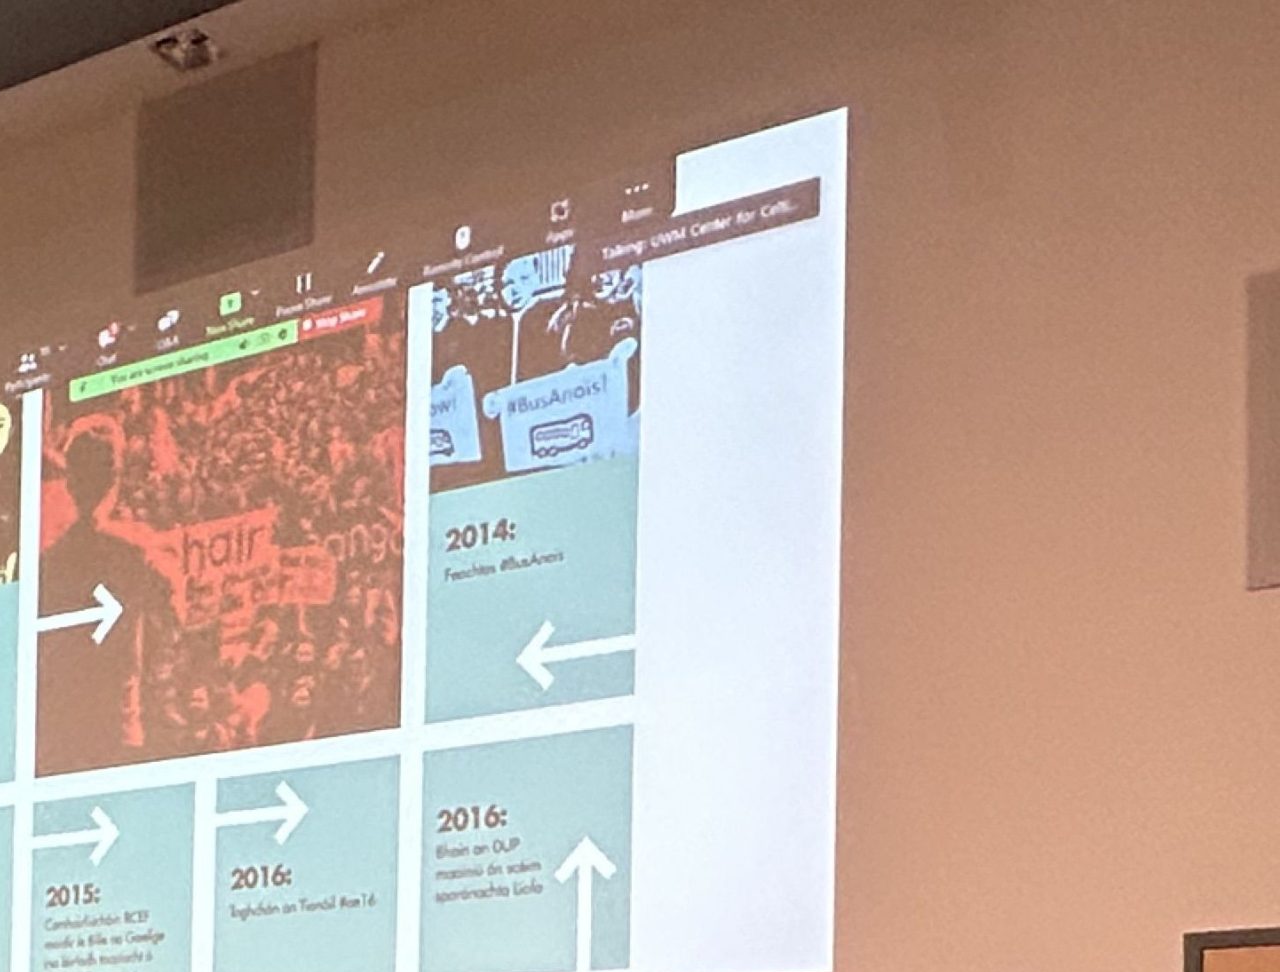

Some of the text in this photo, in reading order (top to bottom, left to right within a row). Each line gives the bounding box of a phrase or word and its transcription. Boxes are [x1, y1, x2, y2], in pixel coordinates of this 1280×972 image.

[602, 240, 648, 260] Talking:
[650, 226, 686, 248] UWM
[689, 213, 732, 237] Center
[735, 208, 757, 224] for
[507, 373, 608, 417] #BusAnois!
[445, 517, 517, 553] 2014:
[437, 804, 508, 833] 2016:
[231, 863, 293, 891] 2016:
[45, 882, 101, 908] 2015:
